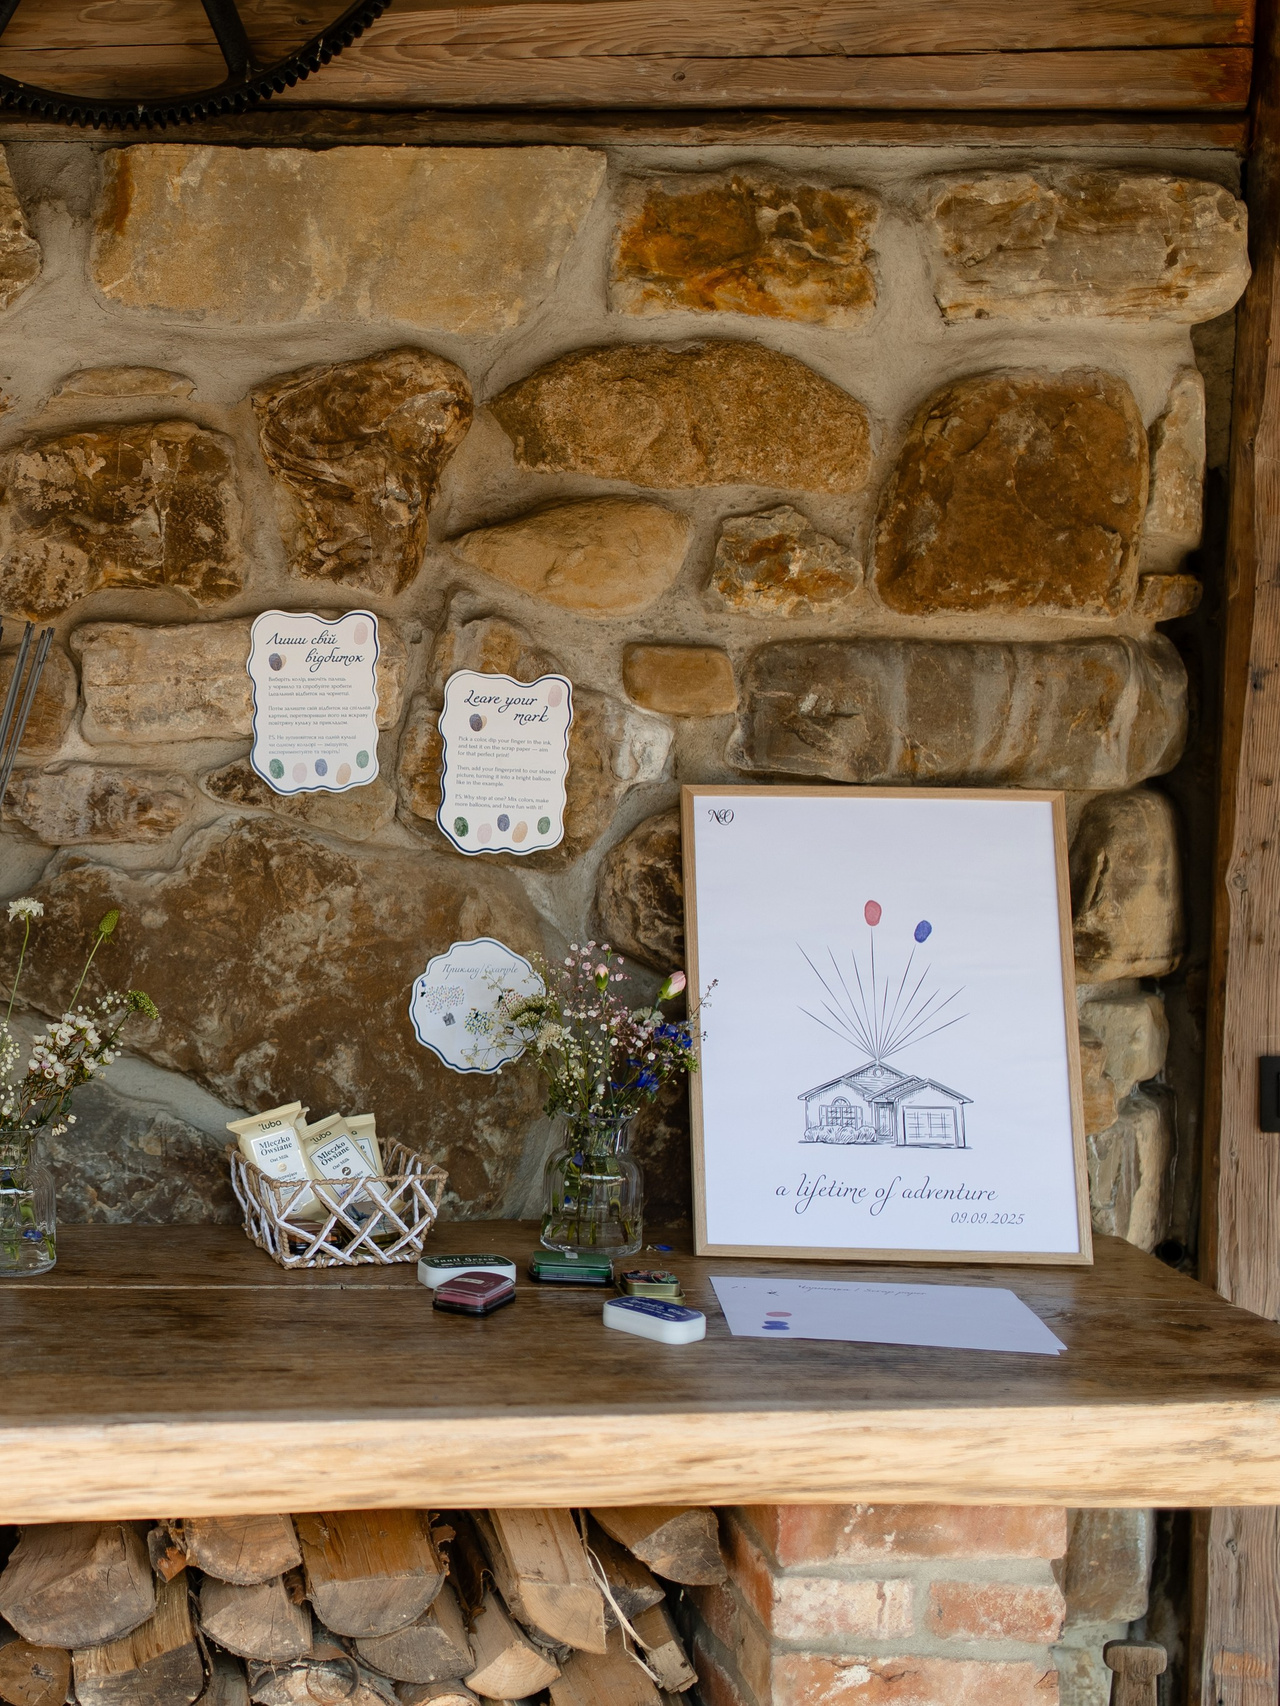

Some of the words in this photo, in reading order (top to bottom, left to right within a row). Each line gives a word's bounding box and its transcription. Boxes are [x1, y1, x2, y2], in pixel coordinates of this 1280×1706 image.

[266, 632, 308, 645] Лиши
[311, 630, 338, 645] свій
[305, 647, 365, 672] відбиток
[464, 690, 501, 707] Leave
[498, 697, 538, 713] your
[514, 706, 550, 726] mark
[477, 751, 495, 759] perfect
[494, 766, 522, 775] fingerprint
[463, 794, 475, 802] Why
[259, 1136, 290, 1150] Mleczko
[260, 1142, 292, 1156] Owsiane
[317, 1142, 346, 1160] Mleczko
[321, 1146, 350, 1166] Owsiane
[775, 1186, 790, 1198] a
[795, 1173, 870, 1216] lifetime
[871, 1175, 903, 1216] of
[902, 1175, 999, 1202] adventure
[950, 1212, 1025, 1226] 09.09.2025
